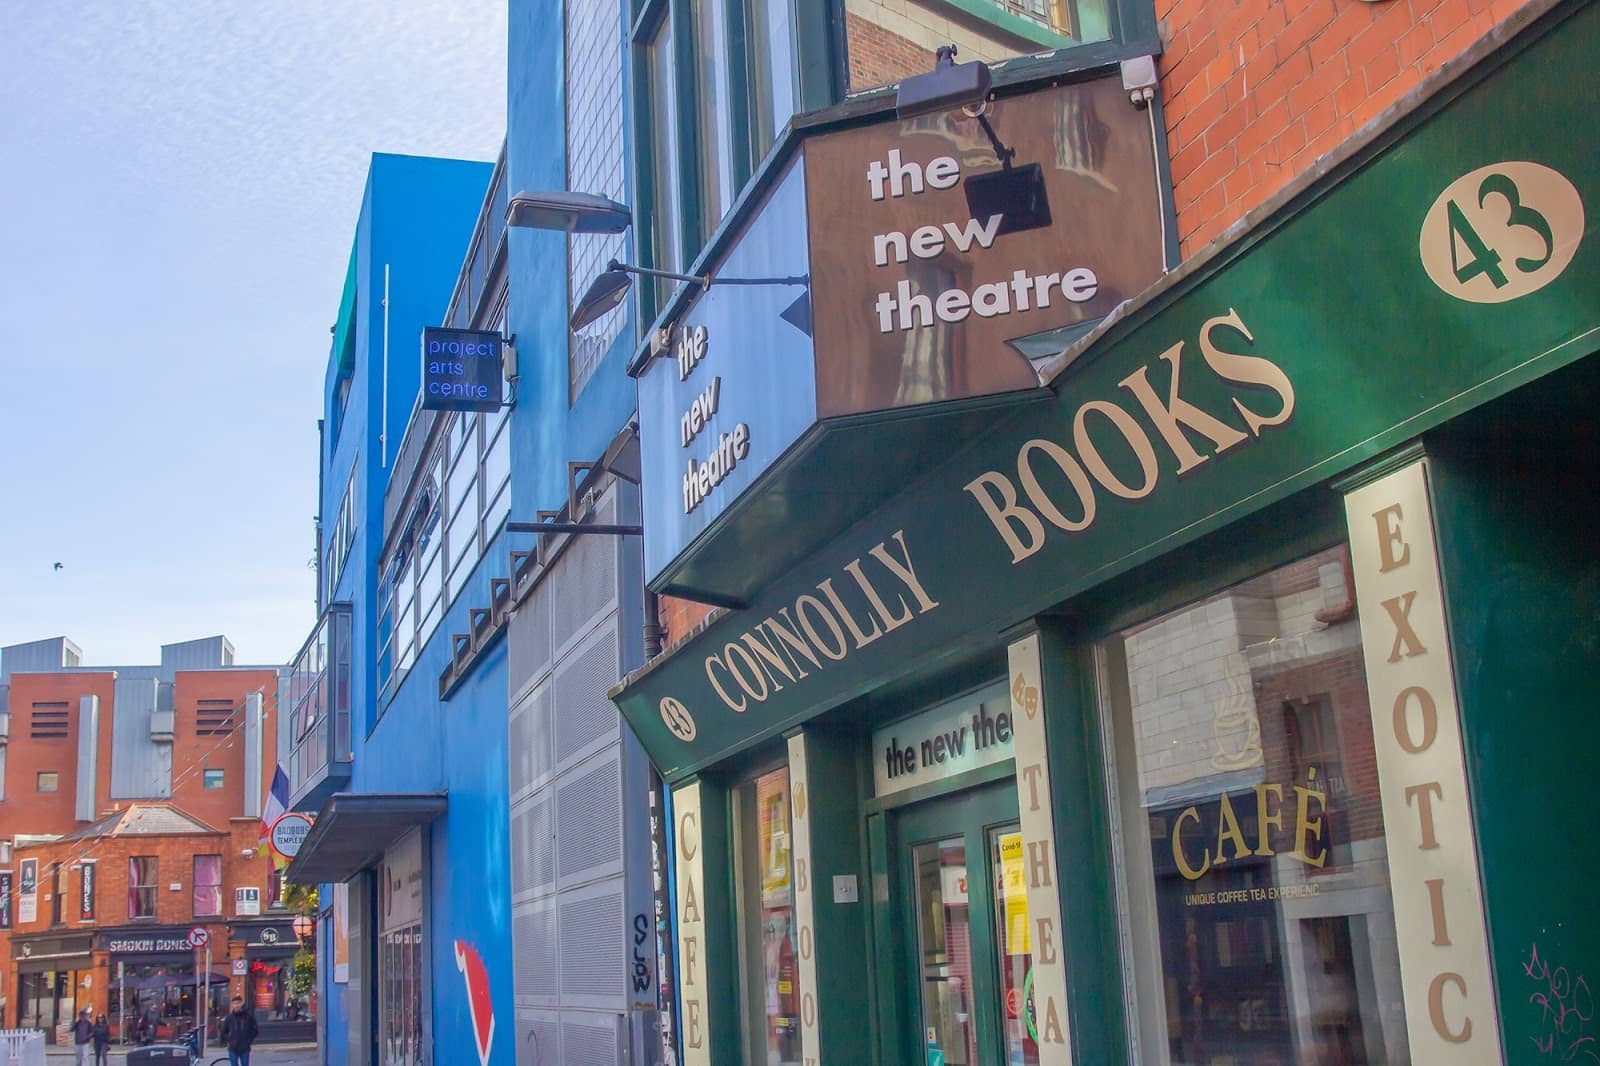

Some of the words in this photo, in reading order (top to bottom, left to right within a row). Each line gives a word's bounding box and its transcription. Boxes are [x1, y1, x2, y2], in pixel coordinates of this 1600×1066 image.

[868, 148, 960, 200] the
[873, 213, 1003, 266] new
[1448, 174, 1555, 289] 43
[876, 267, 1098, 333] theatre
[429, 339, 494, 359] project
[429, 361, 464, 377] arts
[677, 325, 708, 381] the
[429, 382, 489, 398] centre
[681, 376, 721, 448] new
[683, 423, 750, 514] theatre
[705, 529, 940, 713] CONNOLLY
[963, 308, 1296, 565] BOOKS
[662, 699, 692, 736] 43
[886, 737, 916, 778] the
[920, 726, 966, 767] new
[1372, 502, 1473, 1045] EXOTIC
[1172, 767, 1327, 881] CAFÉ
[1185, 893, 1216, 906] UNIQUE
[1217, 889, 1248, 904] COFFEE
[1249, 887, 1267, 901] TEA
[110, 940, 153, 952] SMOKIN
[680, 811, 702, 1049] CAFE
[796, 858, 816, 1066] BOO
